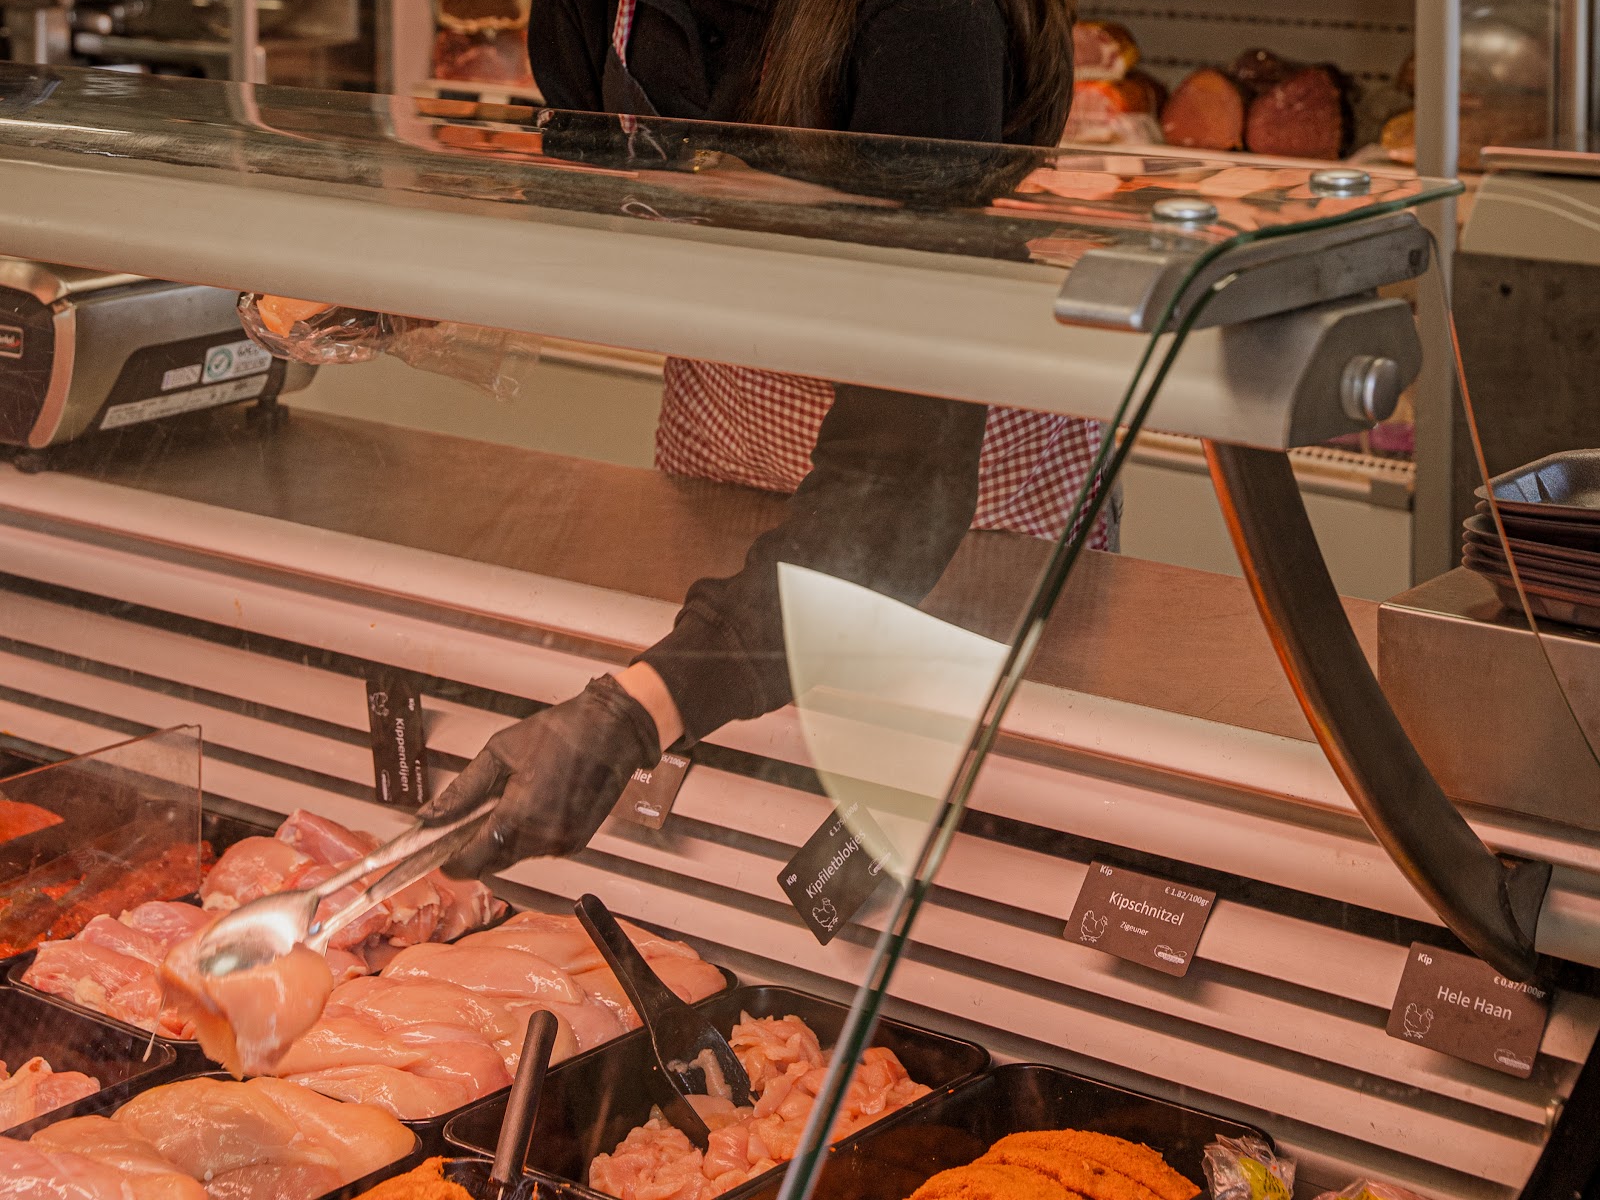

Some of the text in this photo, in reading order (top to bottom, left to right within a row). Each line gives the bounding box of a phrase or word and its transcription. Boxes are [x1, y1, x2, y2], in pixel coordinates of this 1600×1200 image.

[395, 717, 409, 792] Kippendijen
[631, 768, 652, 784] ilet
[805, 830, 866, 899] Kipfiletblokjes
[1100, 864, 1113, 876] Kip
[786, 873, 797, 886] Kip
[1164, 886, 1170, 894] €
[1109, 891, 1185, 926] Kipschnitzel
[1119, 920, 1149, 936] Zigeuner
[1417, 952, 1433, 966] Kip
[1493, 976, 1546, 999] € 0,87/100gr
[1437, 985, 1513, 1021] Hele Haan
